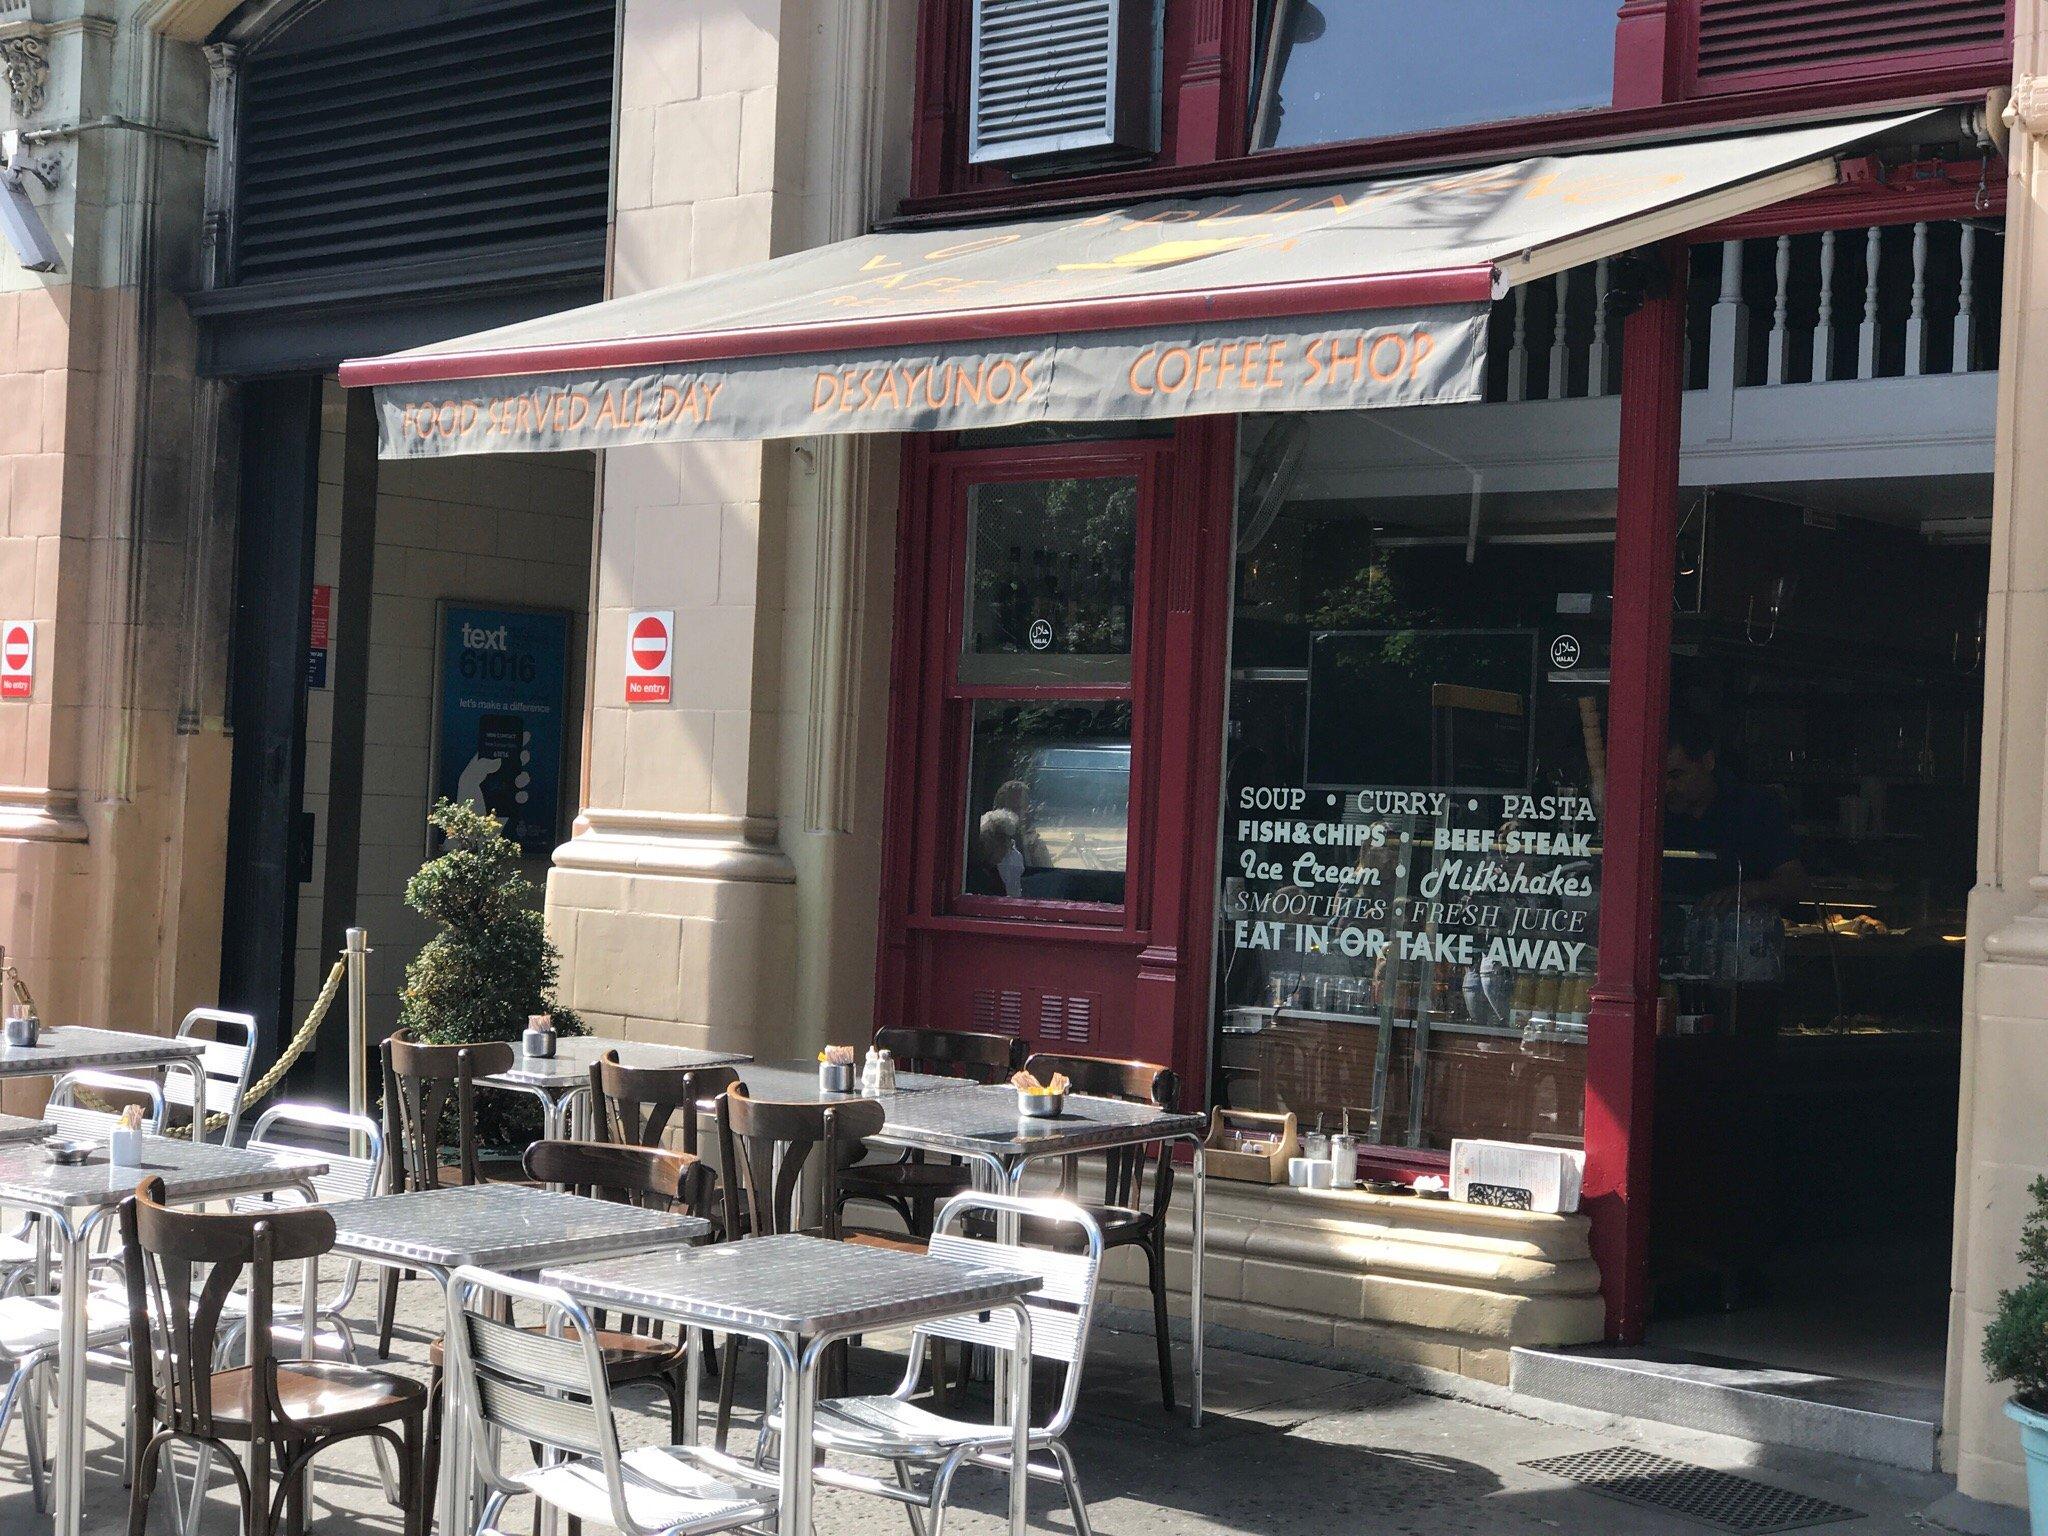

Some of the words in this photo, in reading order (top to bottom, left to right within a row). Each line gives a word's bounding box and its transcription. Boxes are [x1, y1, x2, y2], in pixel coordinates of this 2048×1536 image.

[1129, 340, 1286, 397] COFFEE
[1304, 332, 1436, 387] SHOP
[811, 359, 1036, 415] DESAYUNOS
[402, 402, 477, 440] FOOD
[487, 392, 589, 435] SERVED
[593, 390, 645, 430] ALL
[659, 381, 724, 425] DAY
[461, 621, 508, 651] text
[1554, 642, 1576, 655] حلال
[3, 681, 12, 689] No
[13, 681, 28, 691] entry
[460, 651, 537, 685] 61016
[459, 698, 477, 709] let's
[477, 700, 502, 710] make
[502, 703, 509, 711] a
[509, 701, 551, 714] difference
[630, 683, 641, 693] No
[643, 683, 665, 695] entry
[1239, 786, 1306, 811] SOUP
[1357, 789, 1447, 816] CURRY
[1501, 794, 1596, 822] PASTA
[1237, 819, 1387, 848] FISH&CHIPS
[1433, 827, 1495, 853] BEEF
[1505, 830, 1592, 858] STEAK
[1239, 848, 1284, 881] Ice
[1291, 851, 1382, 888] Cream
[1419, 858, 1594, 899] Milkshakes
[1234, 890, 1388, 921] SMOOTHIES
[1411, 900, 1502, 928] FRESH
[1506, 908, 1588, 936] JUICE
[1235, 920, 1286, 951] EAT
[1295, 922, 1329, 955] IN
[1339, 926, 1386, 961] OR
[1396, 930, 1474, 965] TAKE
[1487, 937, 1587, 973] AWAY
